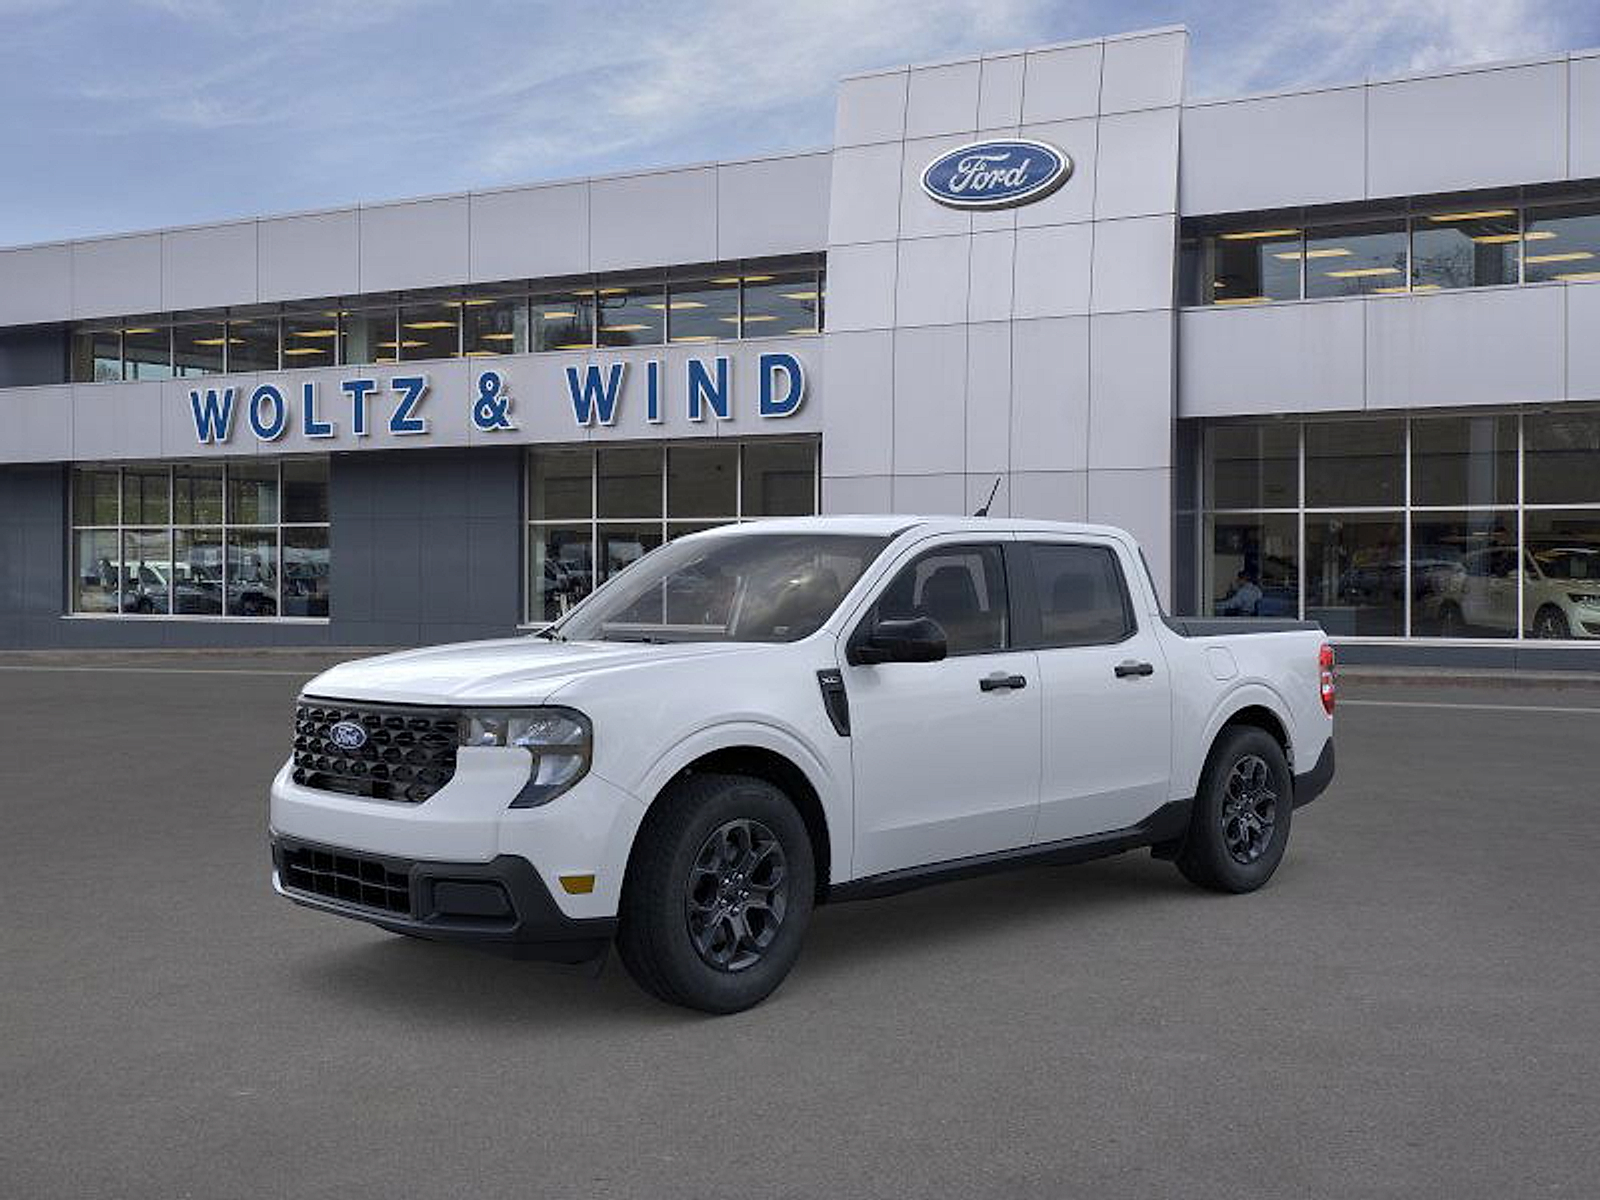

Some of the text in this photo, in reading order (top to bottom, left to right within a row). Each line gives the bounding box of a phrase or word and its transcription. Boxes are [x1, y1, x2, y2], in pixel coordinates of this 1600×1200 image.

[950, 152, 1031, 193] Ford
[190, 353, 807, 443] WOLTZ & WIND
